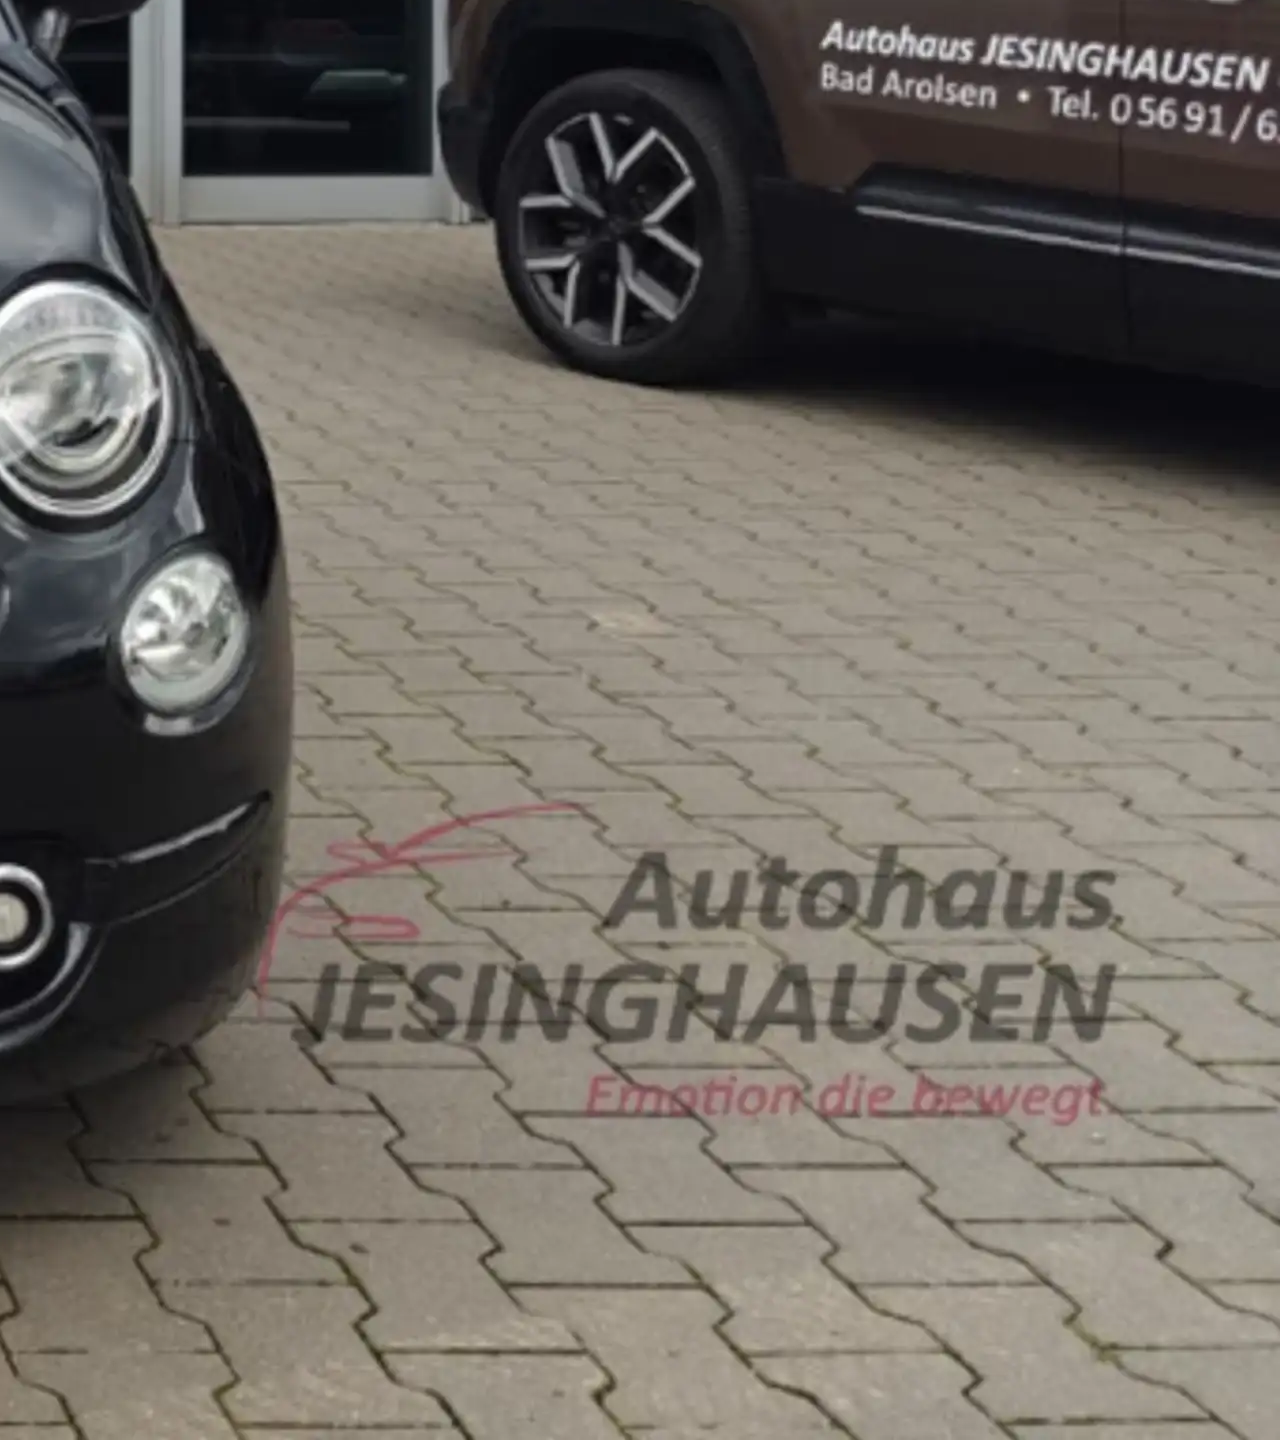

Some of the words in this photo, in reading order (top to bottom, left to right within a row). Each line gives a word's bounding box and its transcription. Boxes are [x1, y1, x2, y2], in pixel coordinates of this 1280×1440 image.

[819, 20, 976, 64] Autohaus
[980, 32, 1271, 93] JESINGHAUSEN
[820, 61, 874, 95] Bad
[881, 69, 998, 109] Arolsen
[1046, 85, 1100, 121] Tel.
